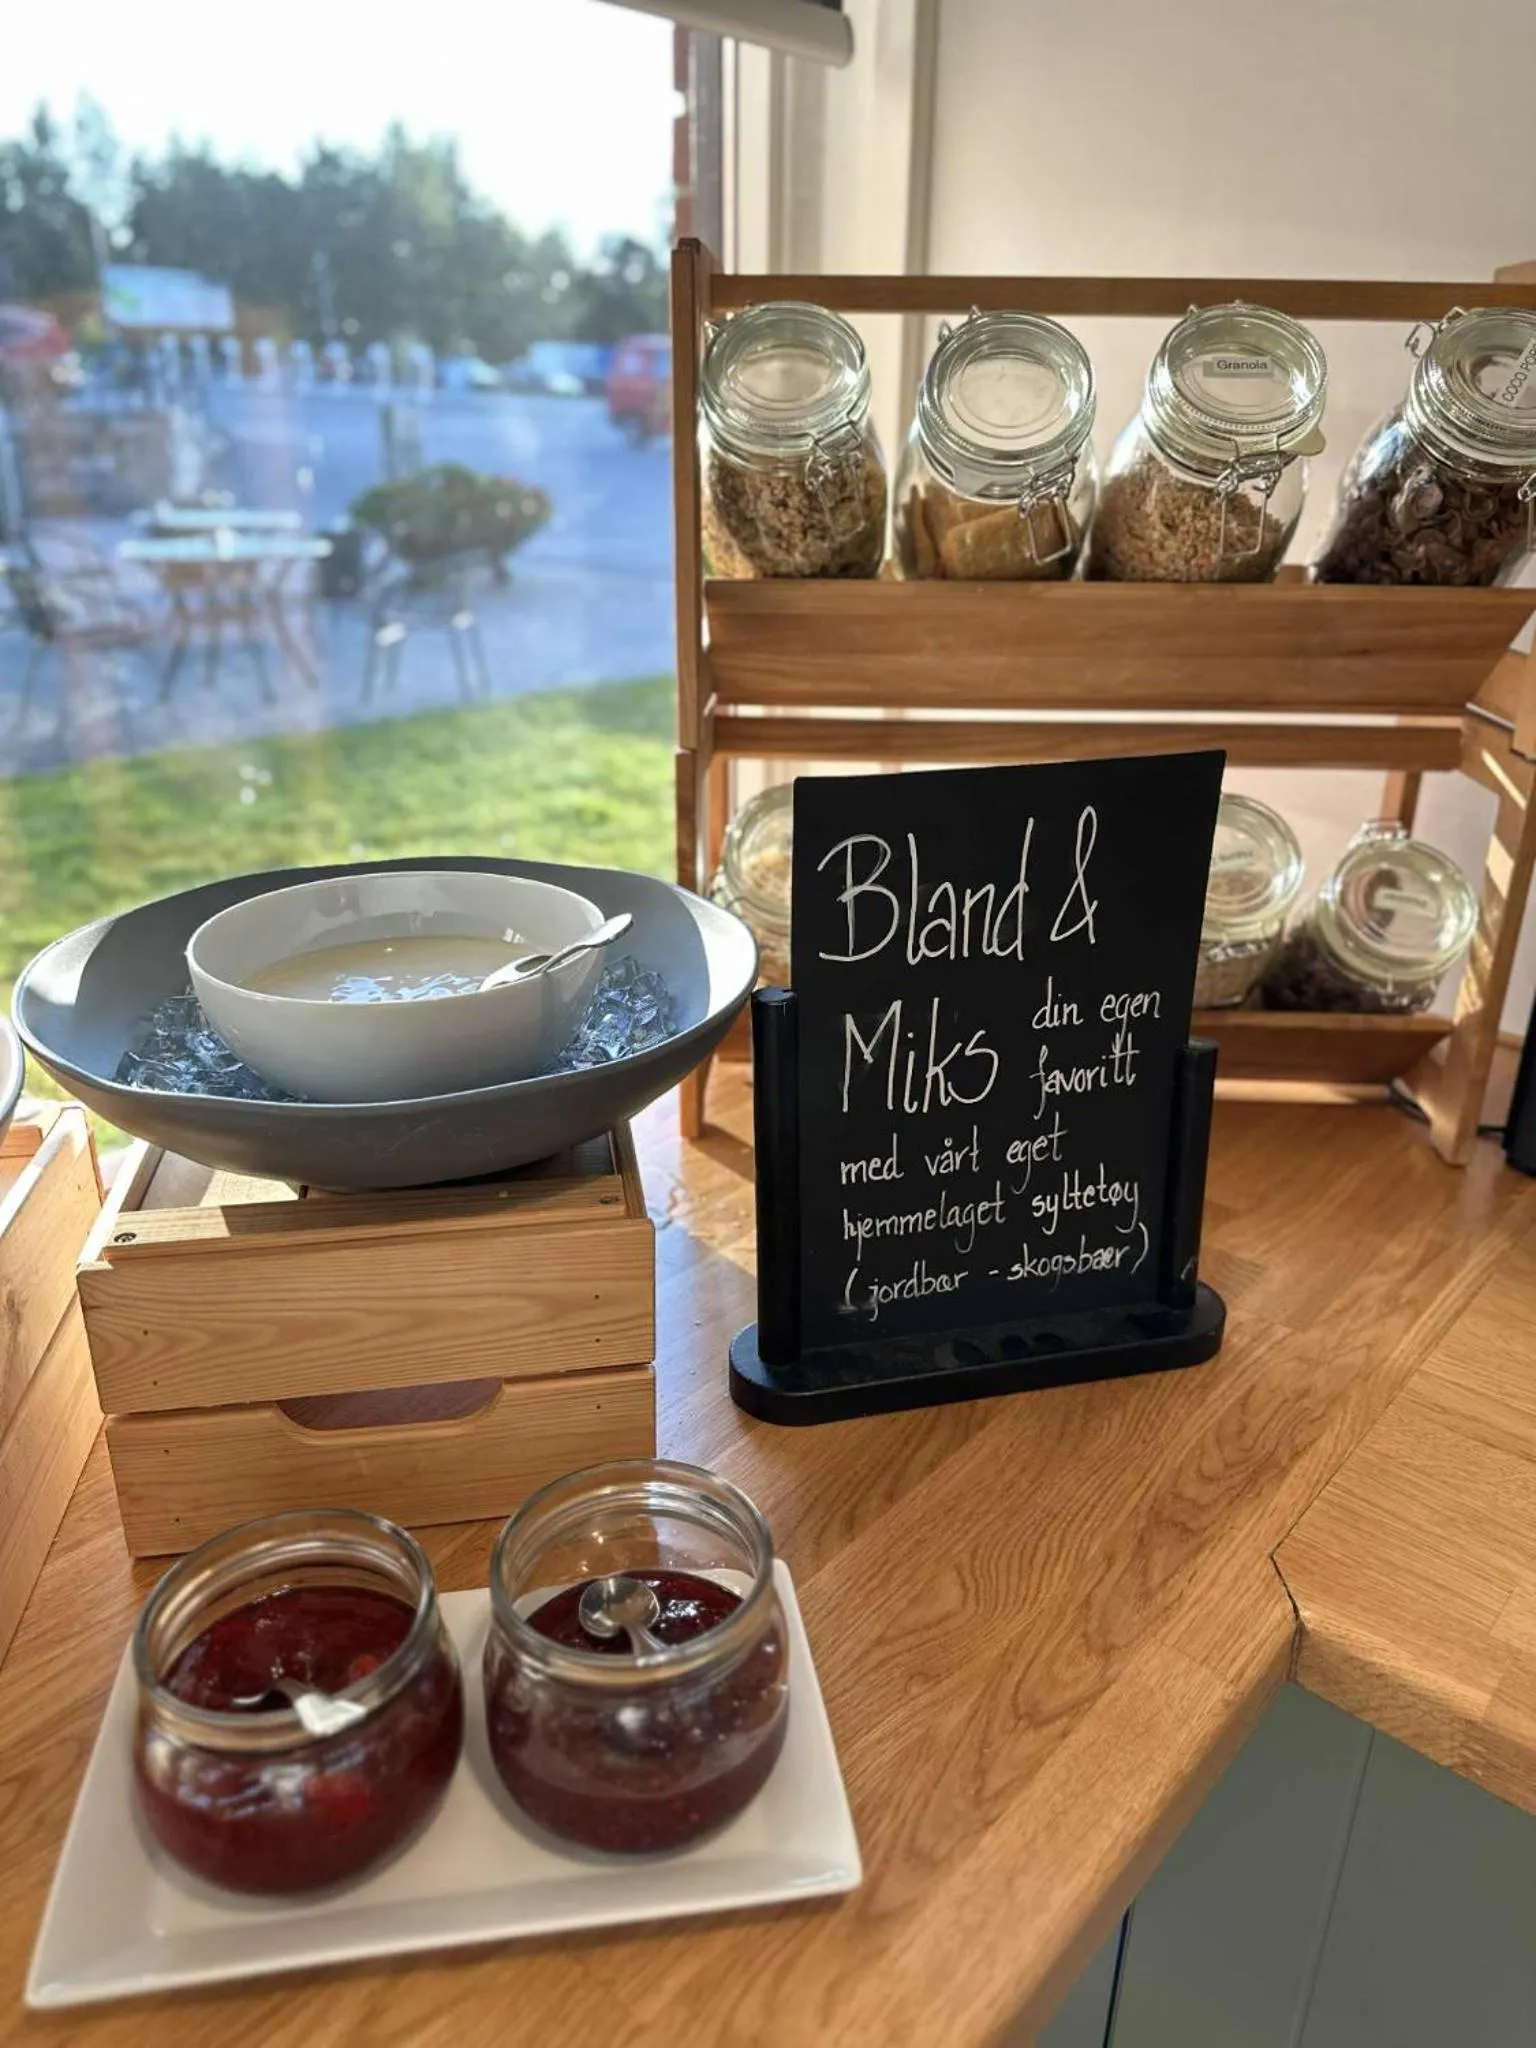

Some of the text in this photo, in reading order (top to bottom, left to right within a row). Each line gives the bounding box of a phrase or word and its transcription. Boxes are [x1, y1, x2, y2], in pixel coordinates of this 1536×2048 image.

[1216, 359, 1268, 370] Granola
[1502, 343, 1536, 402] COCO POP
[818, 805, 1098, 966] Bland &
[1031, 976, 1161, 1042] din egen
[842, 997, 999, 1114] Miks
[1029, 1032, 1140, 1119] favoritt
[841, 1111, 1069, 1195] med vårt eget
[842, 1163, 1140, 1261] hjemmelaget syltetøy
